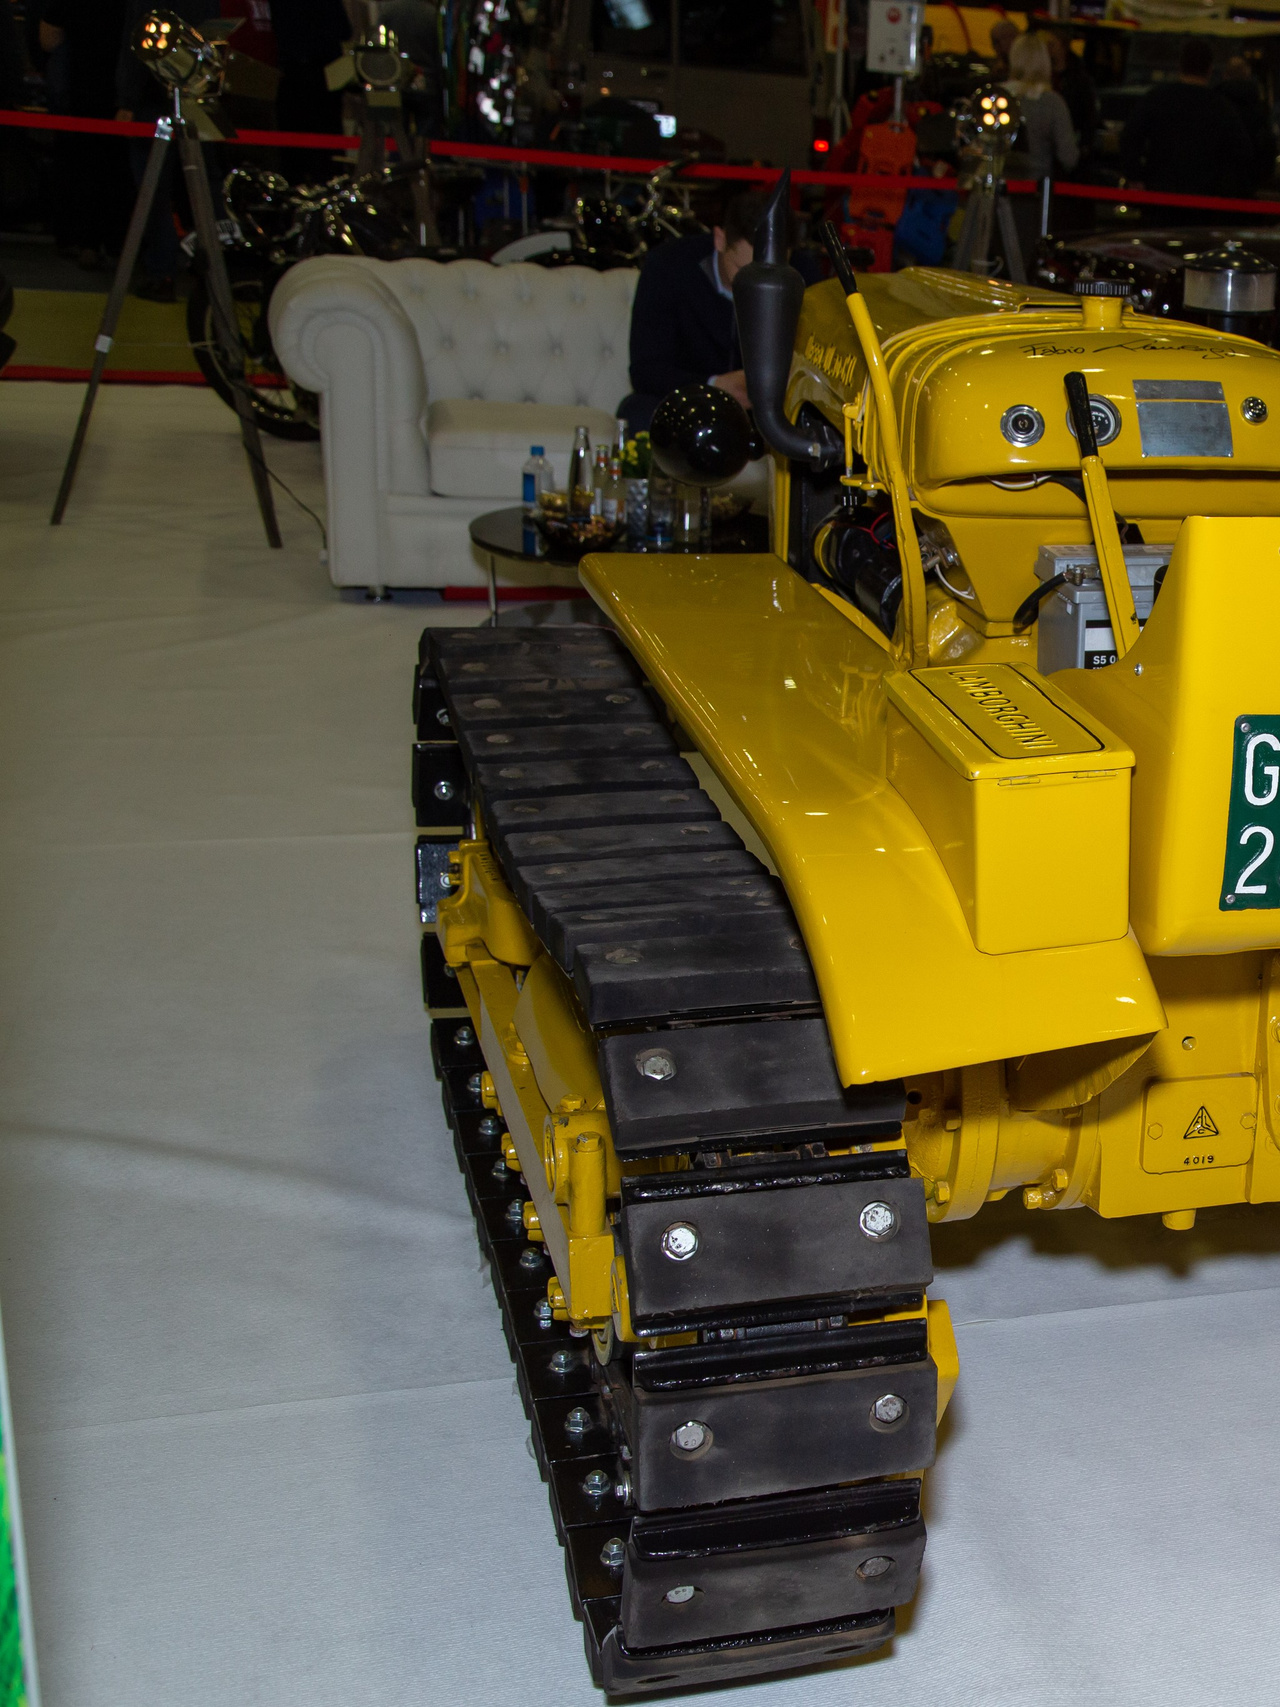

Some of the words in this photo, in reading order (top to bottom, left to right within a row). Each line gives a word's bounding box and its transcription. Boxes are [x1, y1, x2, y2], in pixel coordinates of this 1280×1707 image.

[1019, 342, 1085, 357] Fabio
[1092, 655, 1107, 665] S5
[1109, 655, 1117, 665] 0
[948, 669, 1058, 750] LAMBORGHINI
[1183, 1155, 1215, 1166] 4019
